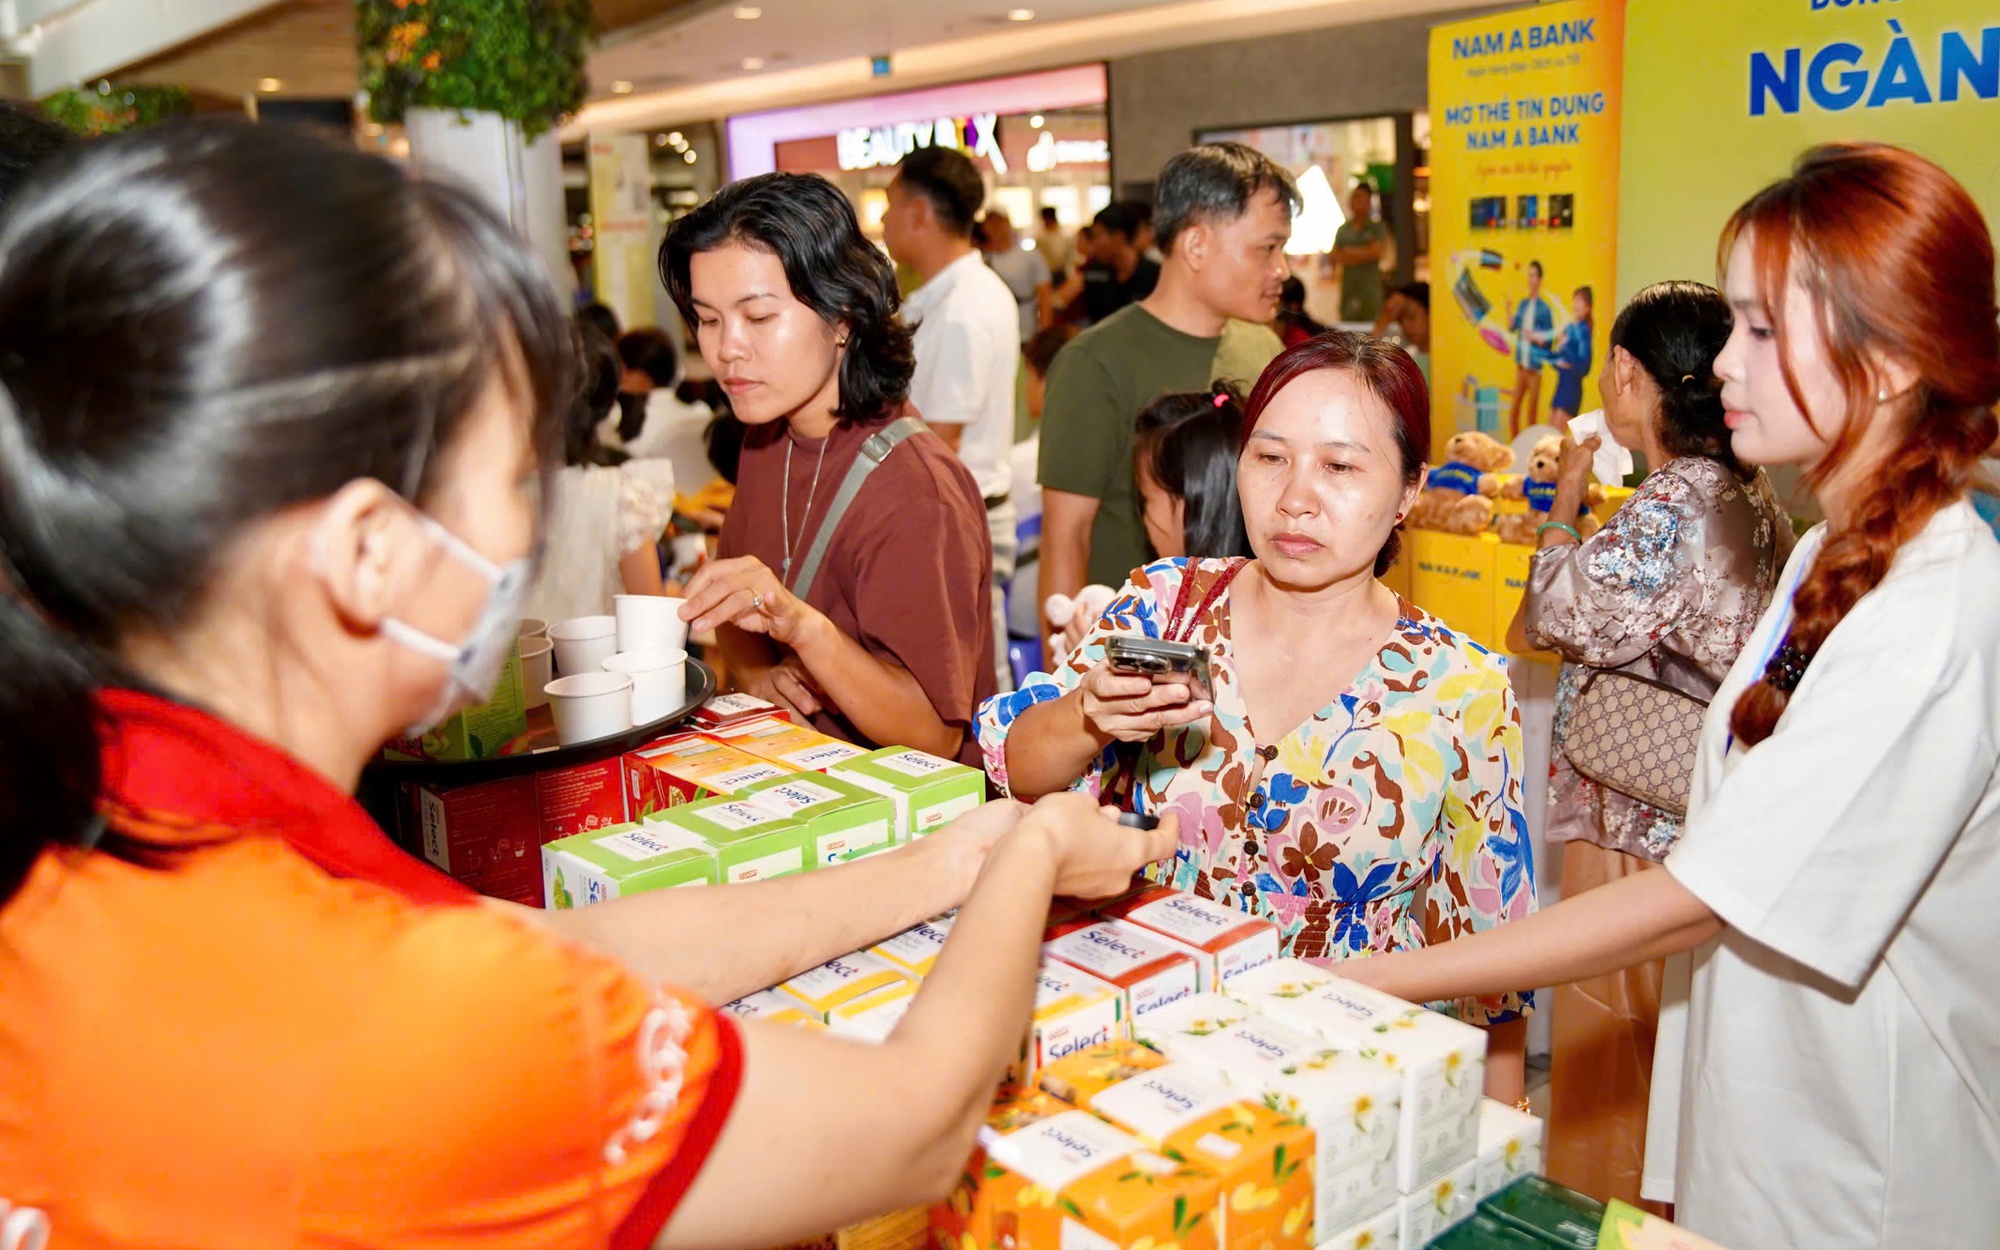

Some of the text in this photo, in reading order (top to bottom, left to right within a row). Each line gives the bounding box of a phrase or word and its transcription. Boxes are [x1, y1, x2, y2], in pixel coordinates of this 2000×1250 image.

[1452, 18, 1596, 61] NAM A BANK
[1749, 18, 2000, 117] NGÀN
[1466, 122, 1580, 151] NAM A BANK
[797, 747, 851, 763] Select
[897, 751, 942, 770] Select
[720, 768, 776, 786] Select
[775, 786, 817, 805] Select
[429, 800, 440, 857] Select
[624, 832, 669, 852] Select
[1165, 898, 1229, 926] Select
[1081, 930, 1146, 960] Select
[1049, 1025, 1109, 1059] Select
